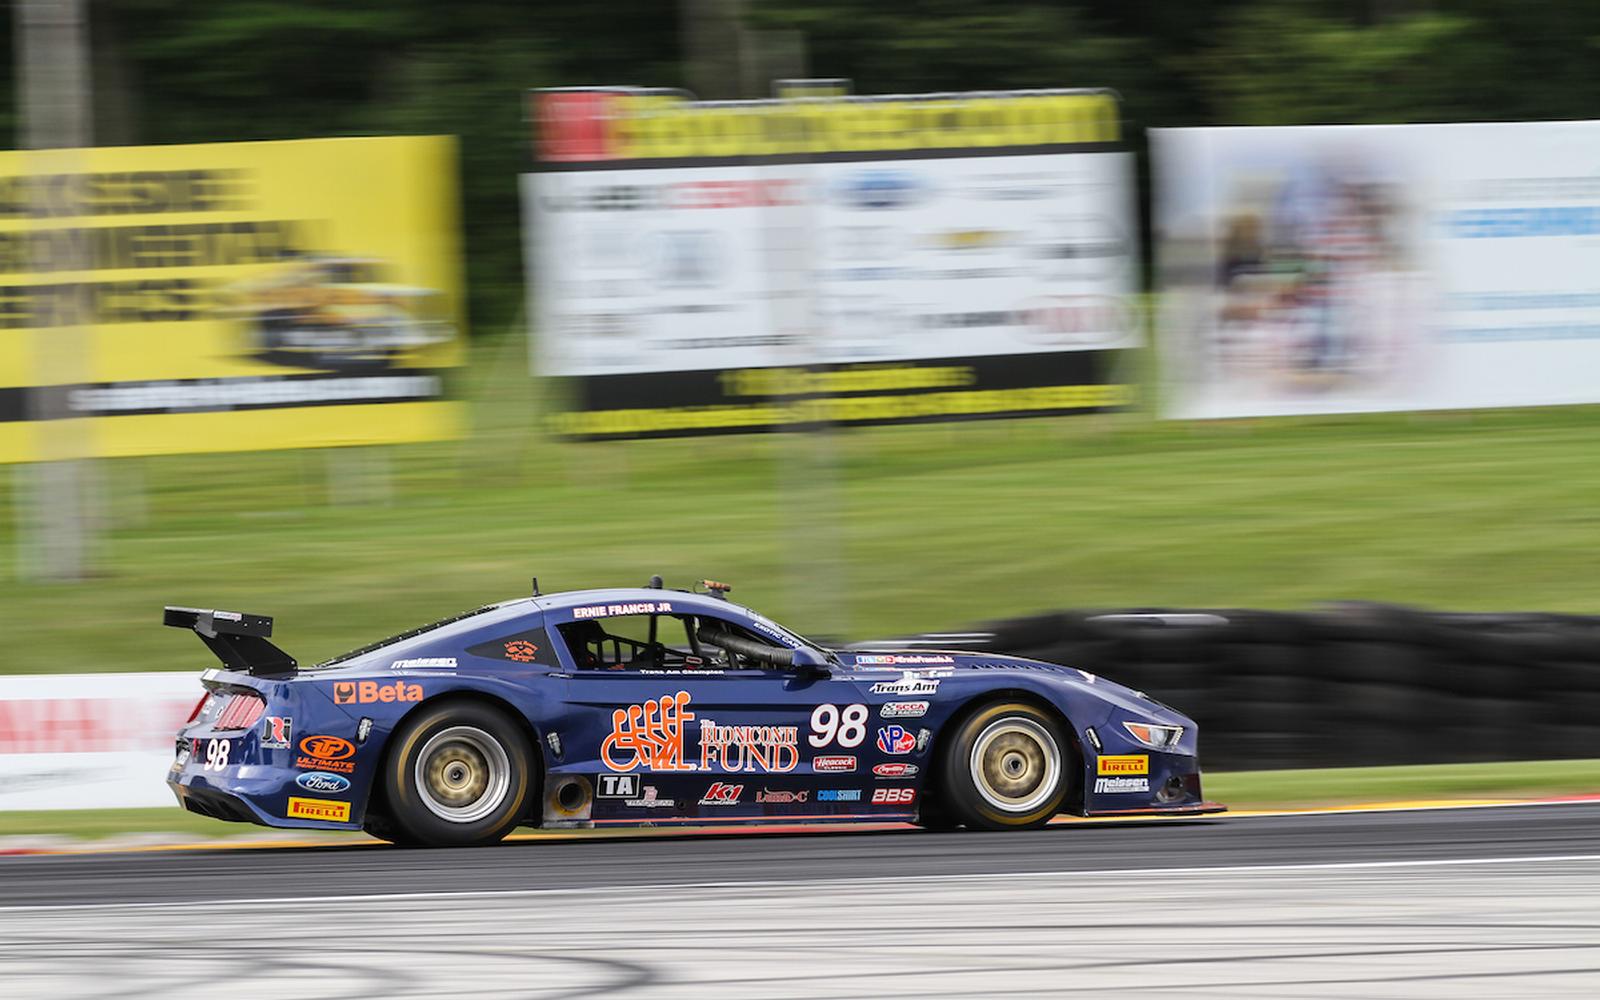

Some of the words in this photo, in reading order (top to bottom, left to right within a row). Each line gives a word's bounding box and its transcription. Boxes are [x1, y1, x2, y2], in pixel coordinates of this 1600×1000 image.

[573, 606, 607, 618] ERNIE
[608, 603, 655, 615] FRANCIS
[657, 603, 672, 612] JR
[358, 681, 424, 702] Beta
[875, 684, 910, 693] Trans
[912, 682, 936, 692] Am
[808, 703, 869, 749] 98
[878, 725, 905, 753] VP
[204, 738, 231, 772] 98
[698, 742, 800, 773] FUND
[297, 757, 356, 771] ULTIMATE
[1102, 759, 1144, 771] PIRELLI
[306, 774, 340, 790] Ford
[603, 776, 633, 795] TA
[704, 782, 744, 801] K1
[872, 788, 916, 803] BBS
[293, 802, 345, 818] PIRELLI
